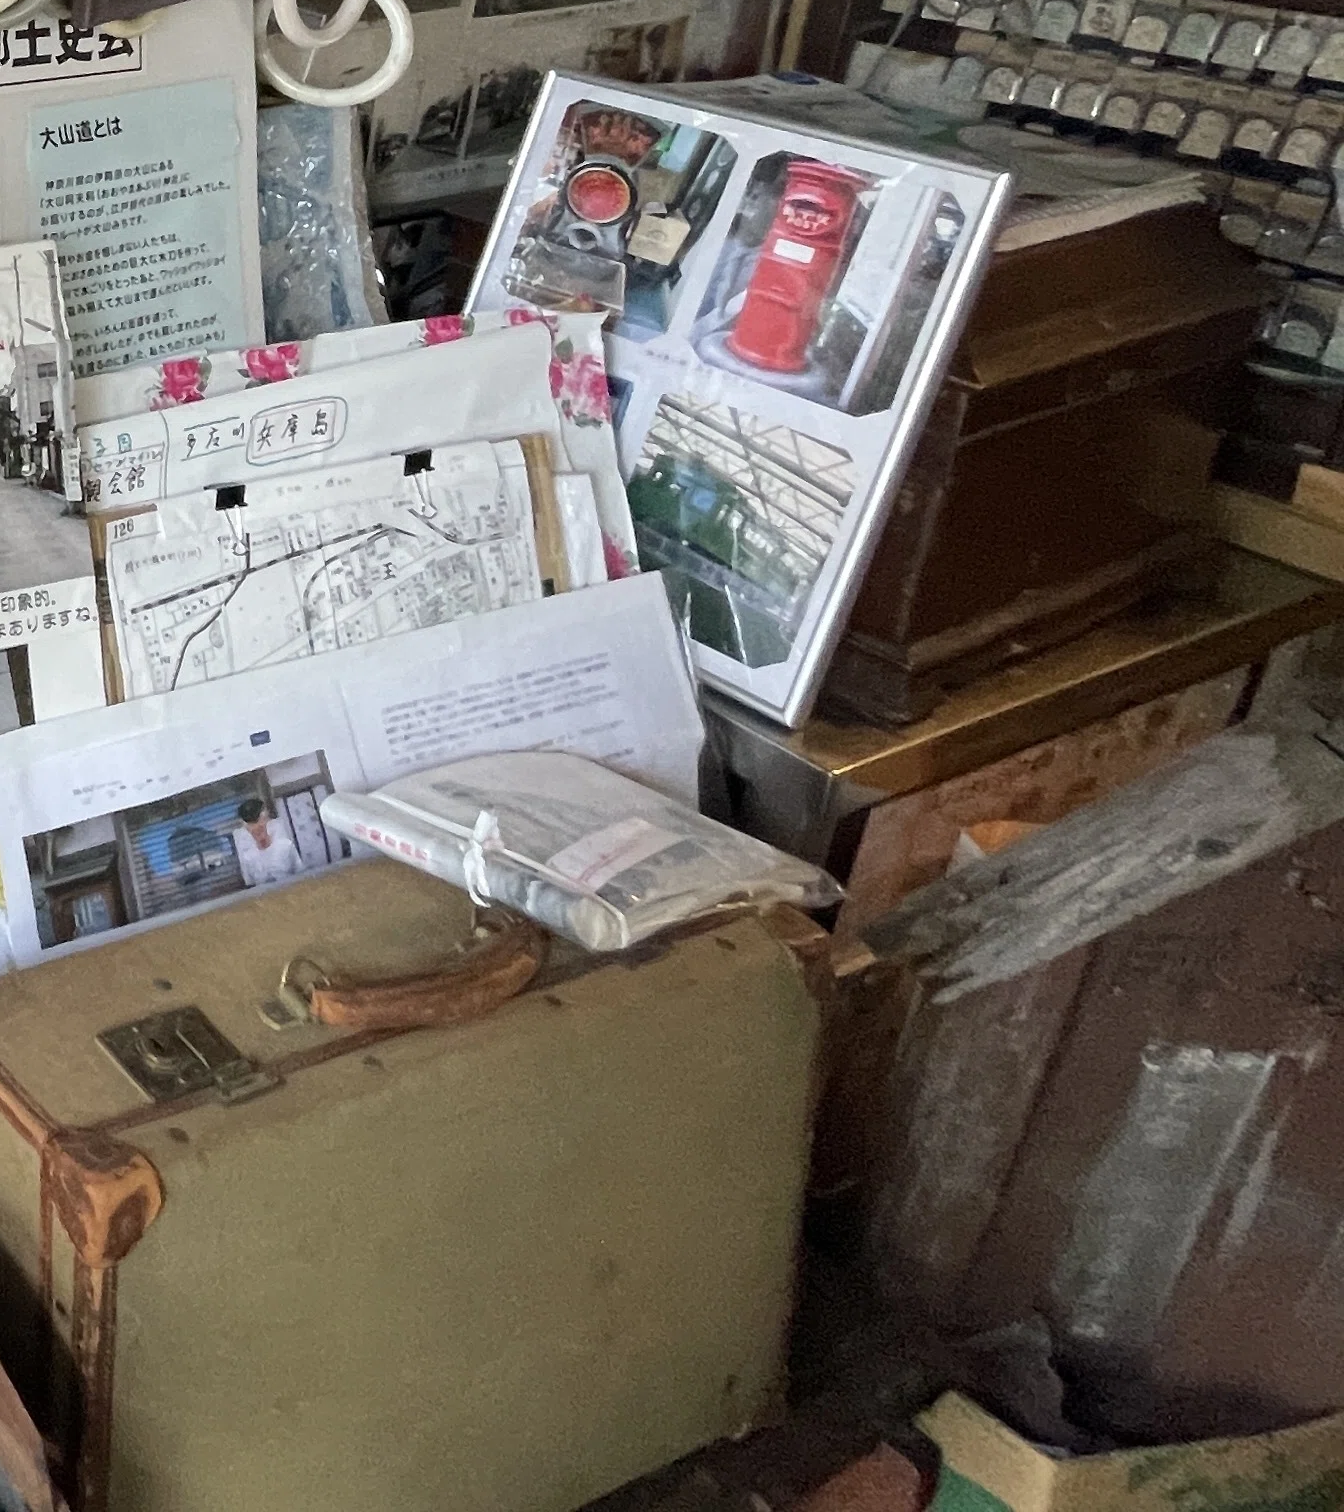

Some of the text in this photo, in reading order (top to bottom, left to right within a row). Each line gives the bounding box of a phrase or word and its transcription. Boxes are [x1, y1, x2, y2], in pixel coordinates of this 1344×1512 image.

[39, 115, 124, 150] 大山道とは
[257, 409, 329, 451] 兵庫島
[112, 521, 135, 539] 126
